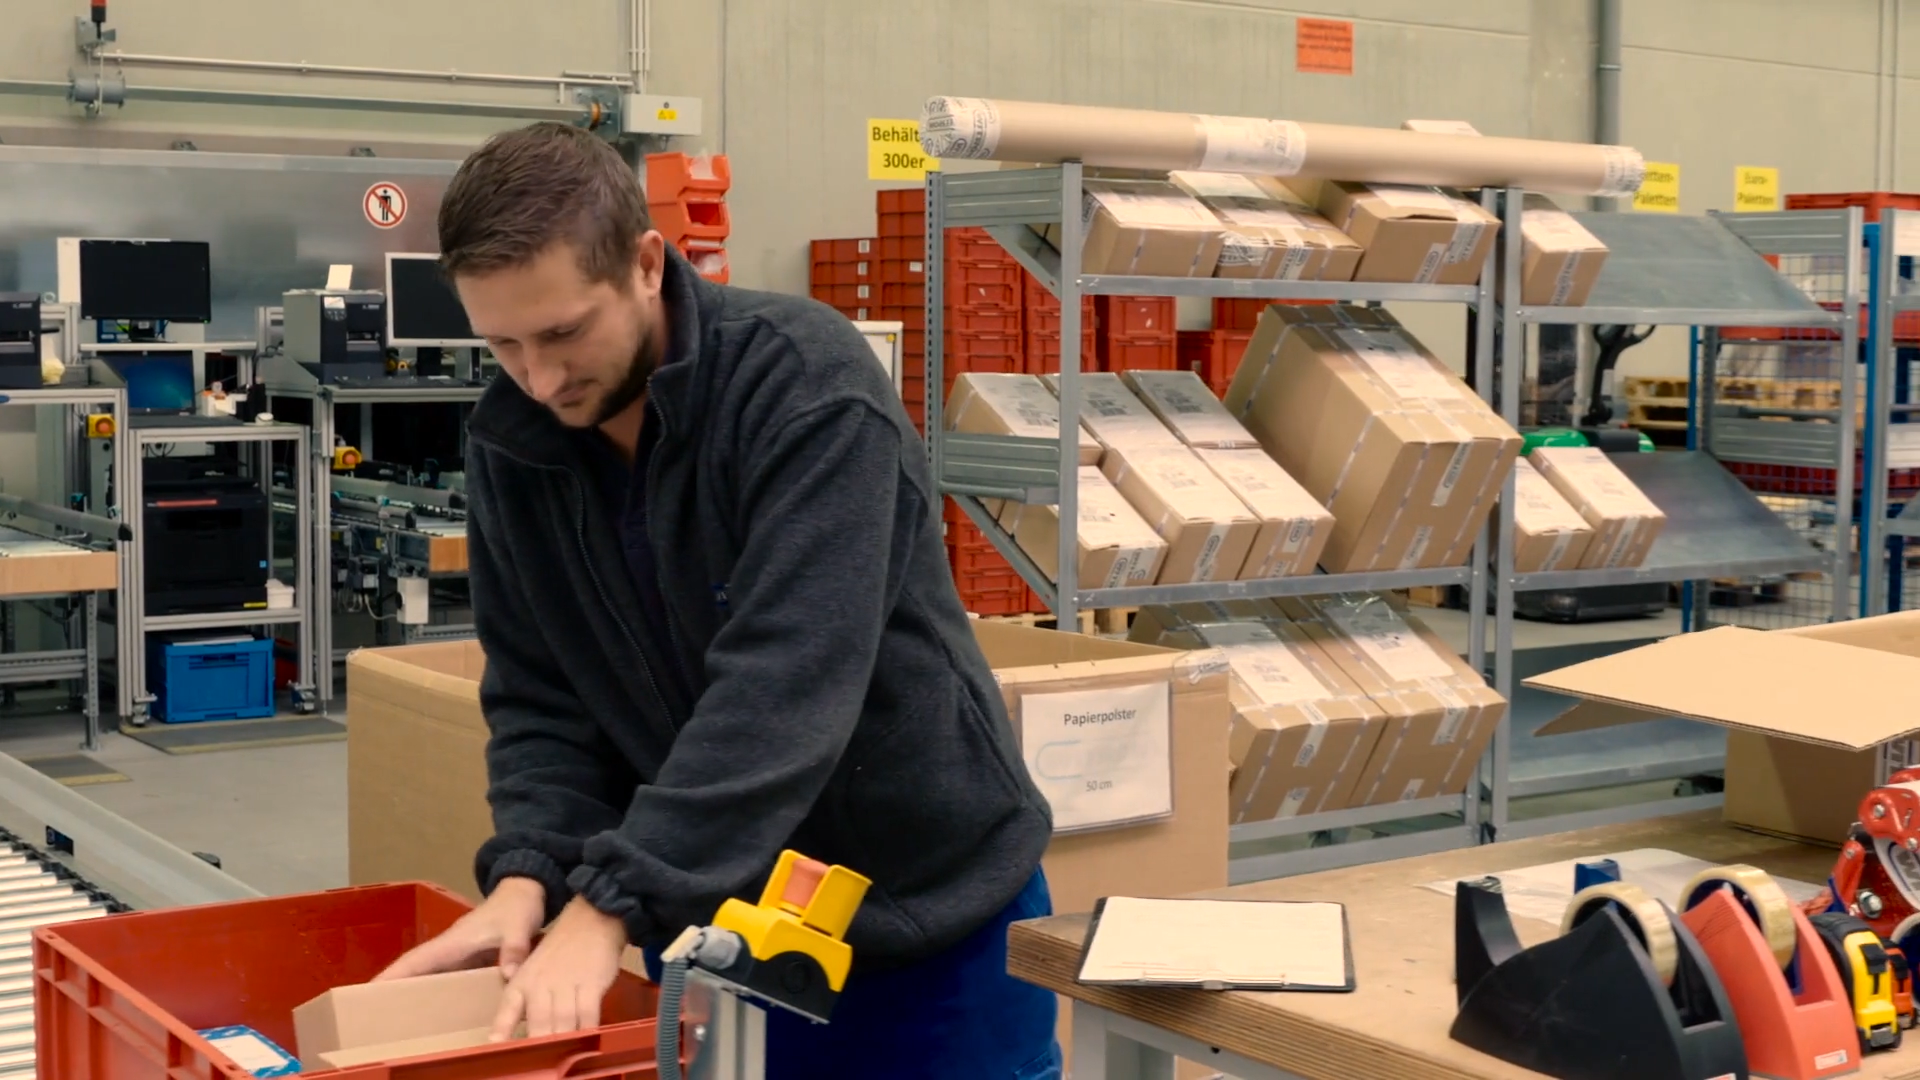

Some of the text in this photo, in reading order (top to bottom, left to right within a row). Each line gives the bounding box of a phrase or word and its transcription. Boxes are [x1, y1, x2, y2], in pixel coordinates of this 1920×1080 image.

[872, 126, 920, 142] Behält
[882, 153, 926, 169] 300er
[1063, 709, 1137, 727] Papierpolster
[1086, 780, 1113, 792] 50 cm
